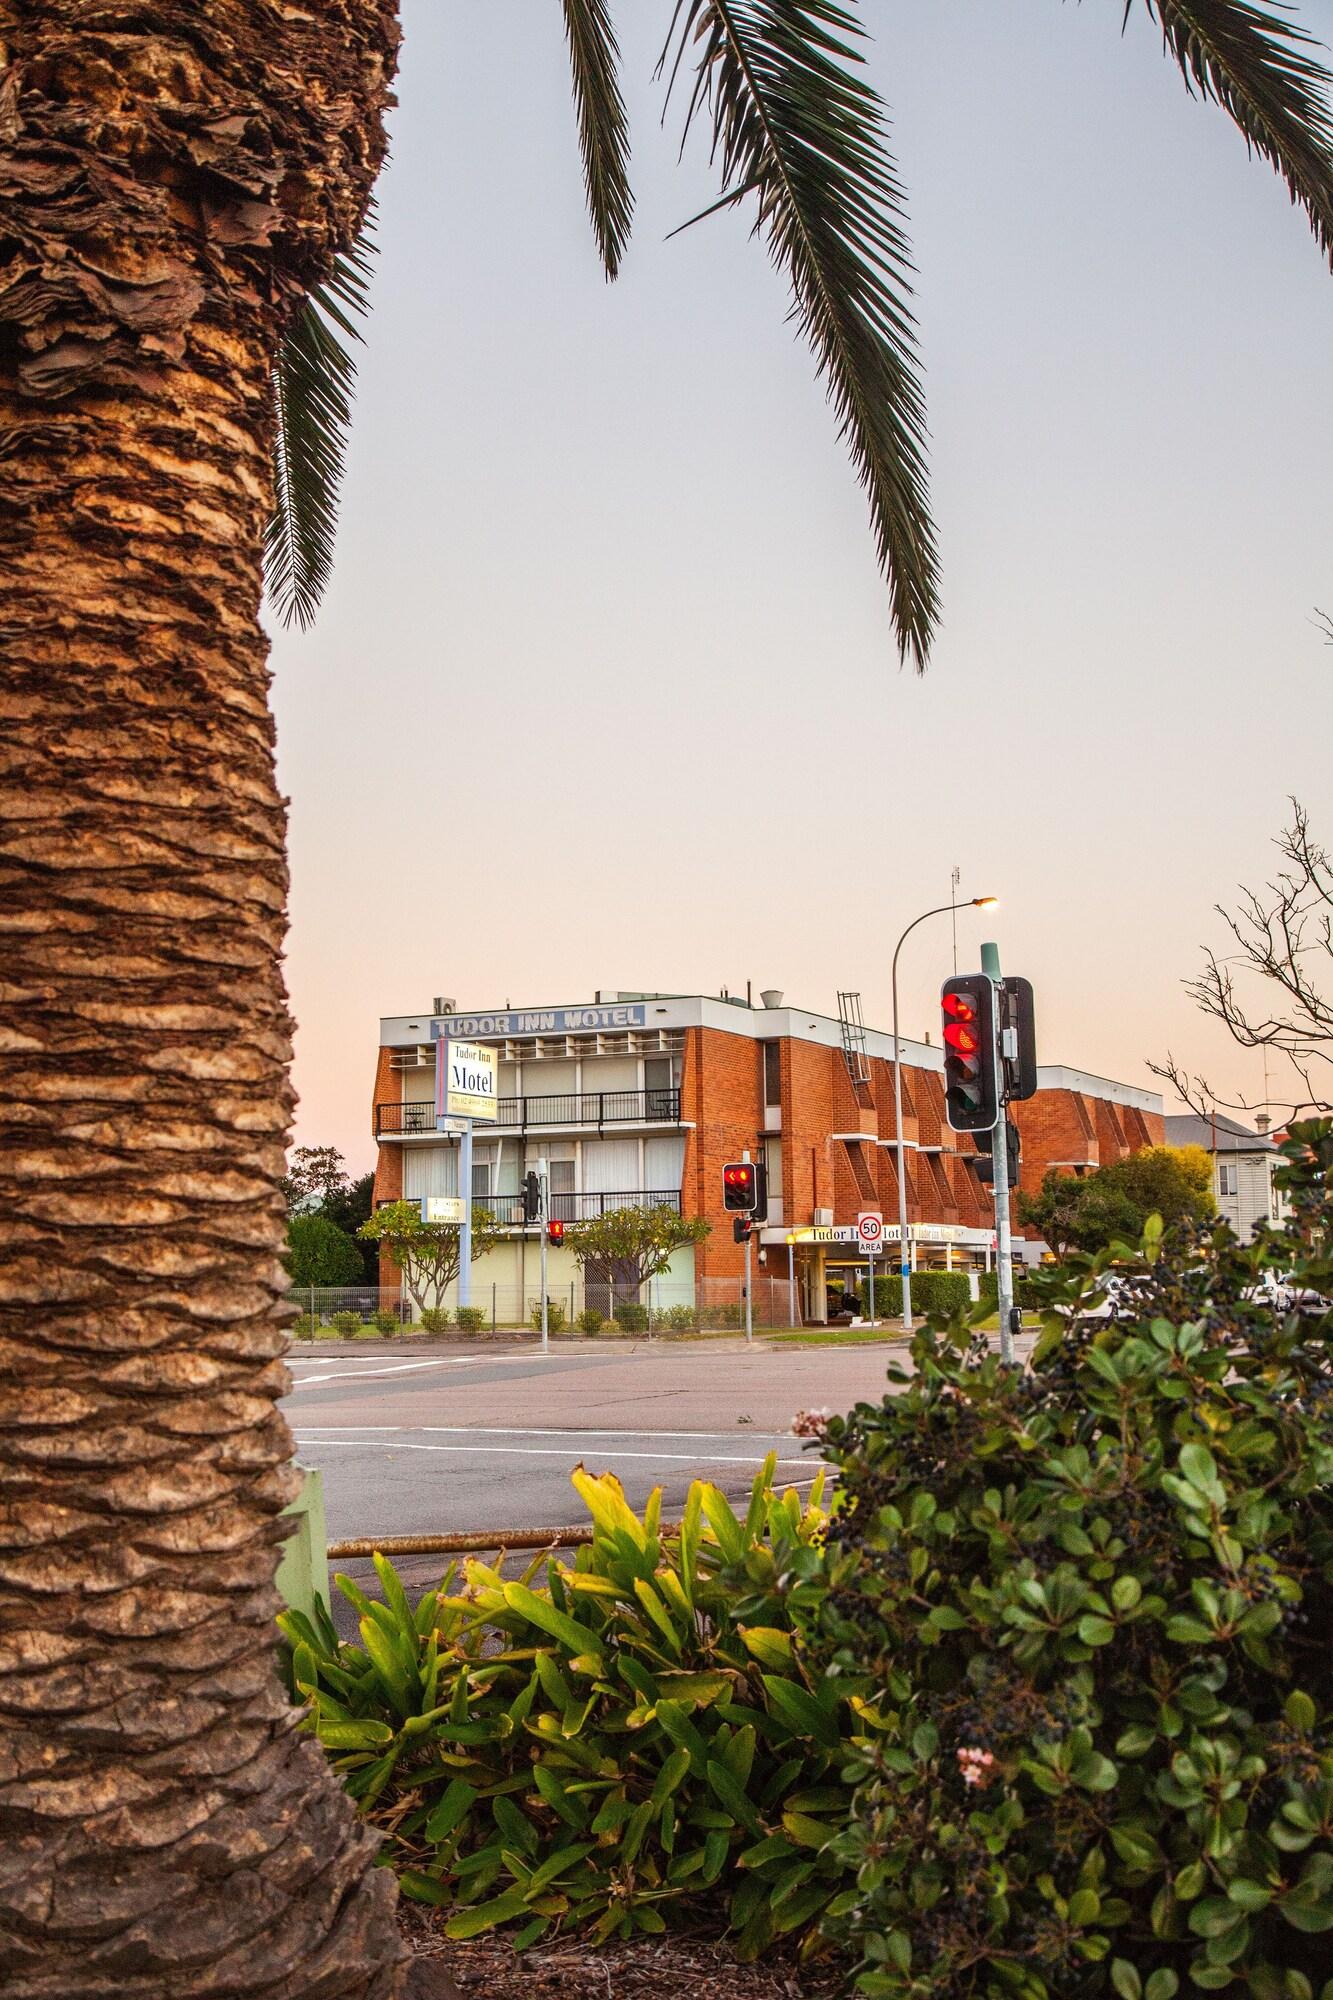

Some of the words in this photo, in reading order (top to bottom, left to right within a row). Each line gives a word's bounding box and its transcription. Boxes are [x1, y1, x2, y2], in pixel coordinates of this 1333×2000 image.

[434, 1015, 510, 1036] TUDOR
[518, 1013, 555, 1032] INN
[564, 1007, 641, 1030] MOTEL
[455, 1045, 477, 1059] Tudor
[478, 1049, 491, 1063] Inn
[452, 1065, 493, 1093] Motel
[811, 1228, 847, 1240] Tudor
[863, 1223, 878, 1234] 50
[860, 1243, 881, 1251] AREA
